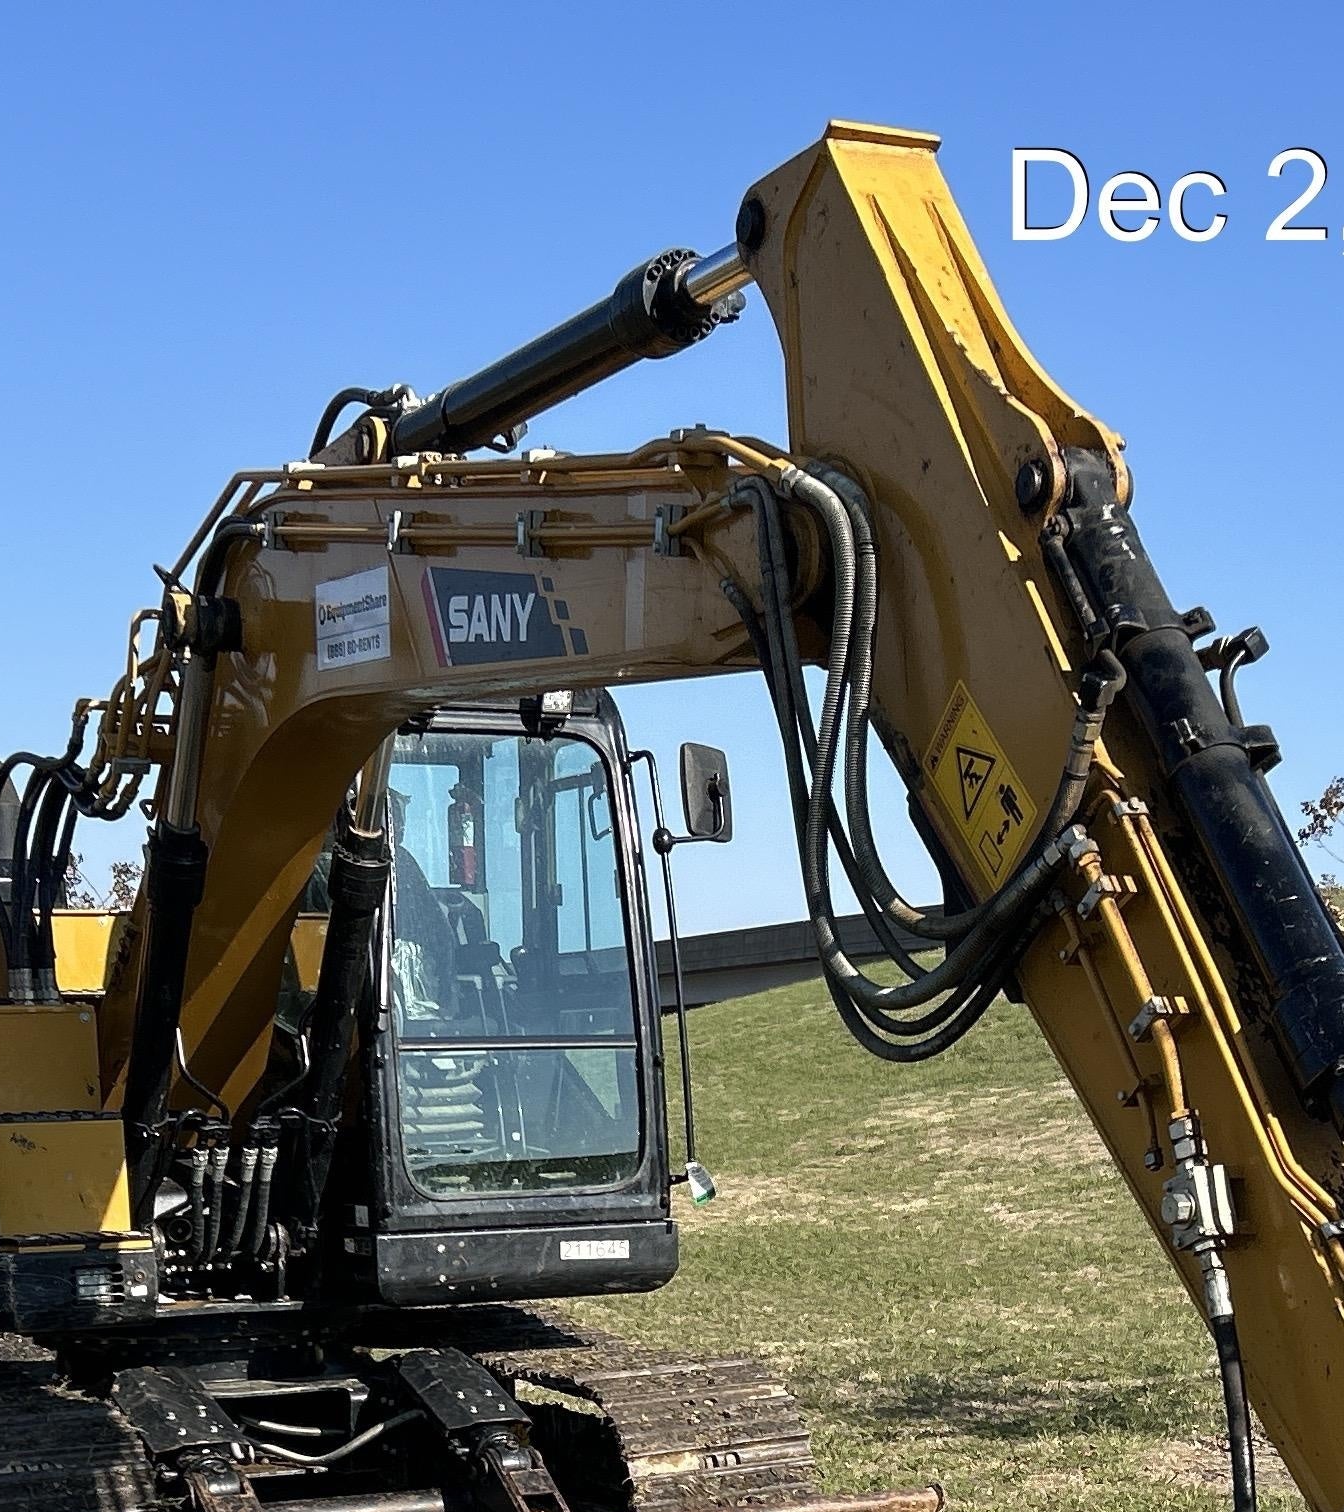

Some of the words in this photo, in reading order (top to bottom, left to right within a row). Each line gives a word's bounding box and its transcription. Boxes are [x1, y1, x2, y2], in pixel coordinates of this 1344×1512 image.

[327, 594, 387, 623] EquipmentShare
[449, 593, 535, 643] SANY
[936, 695, 965, 754] WARNING
[564, 1241, 627, 1258] 211645
